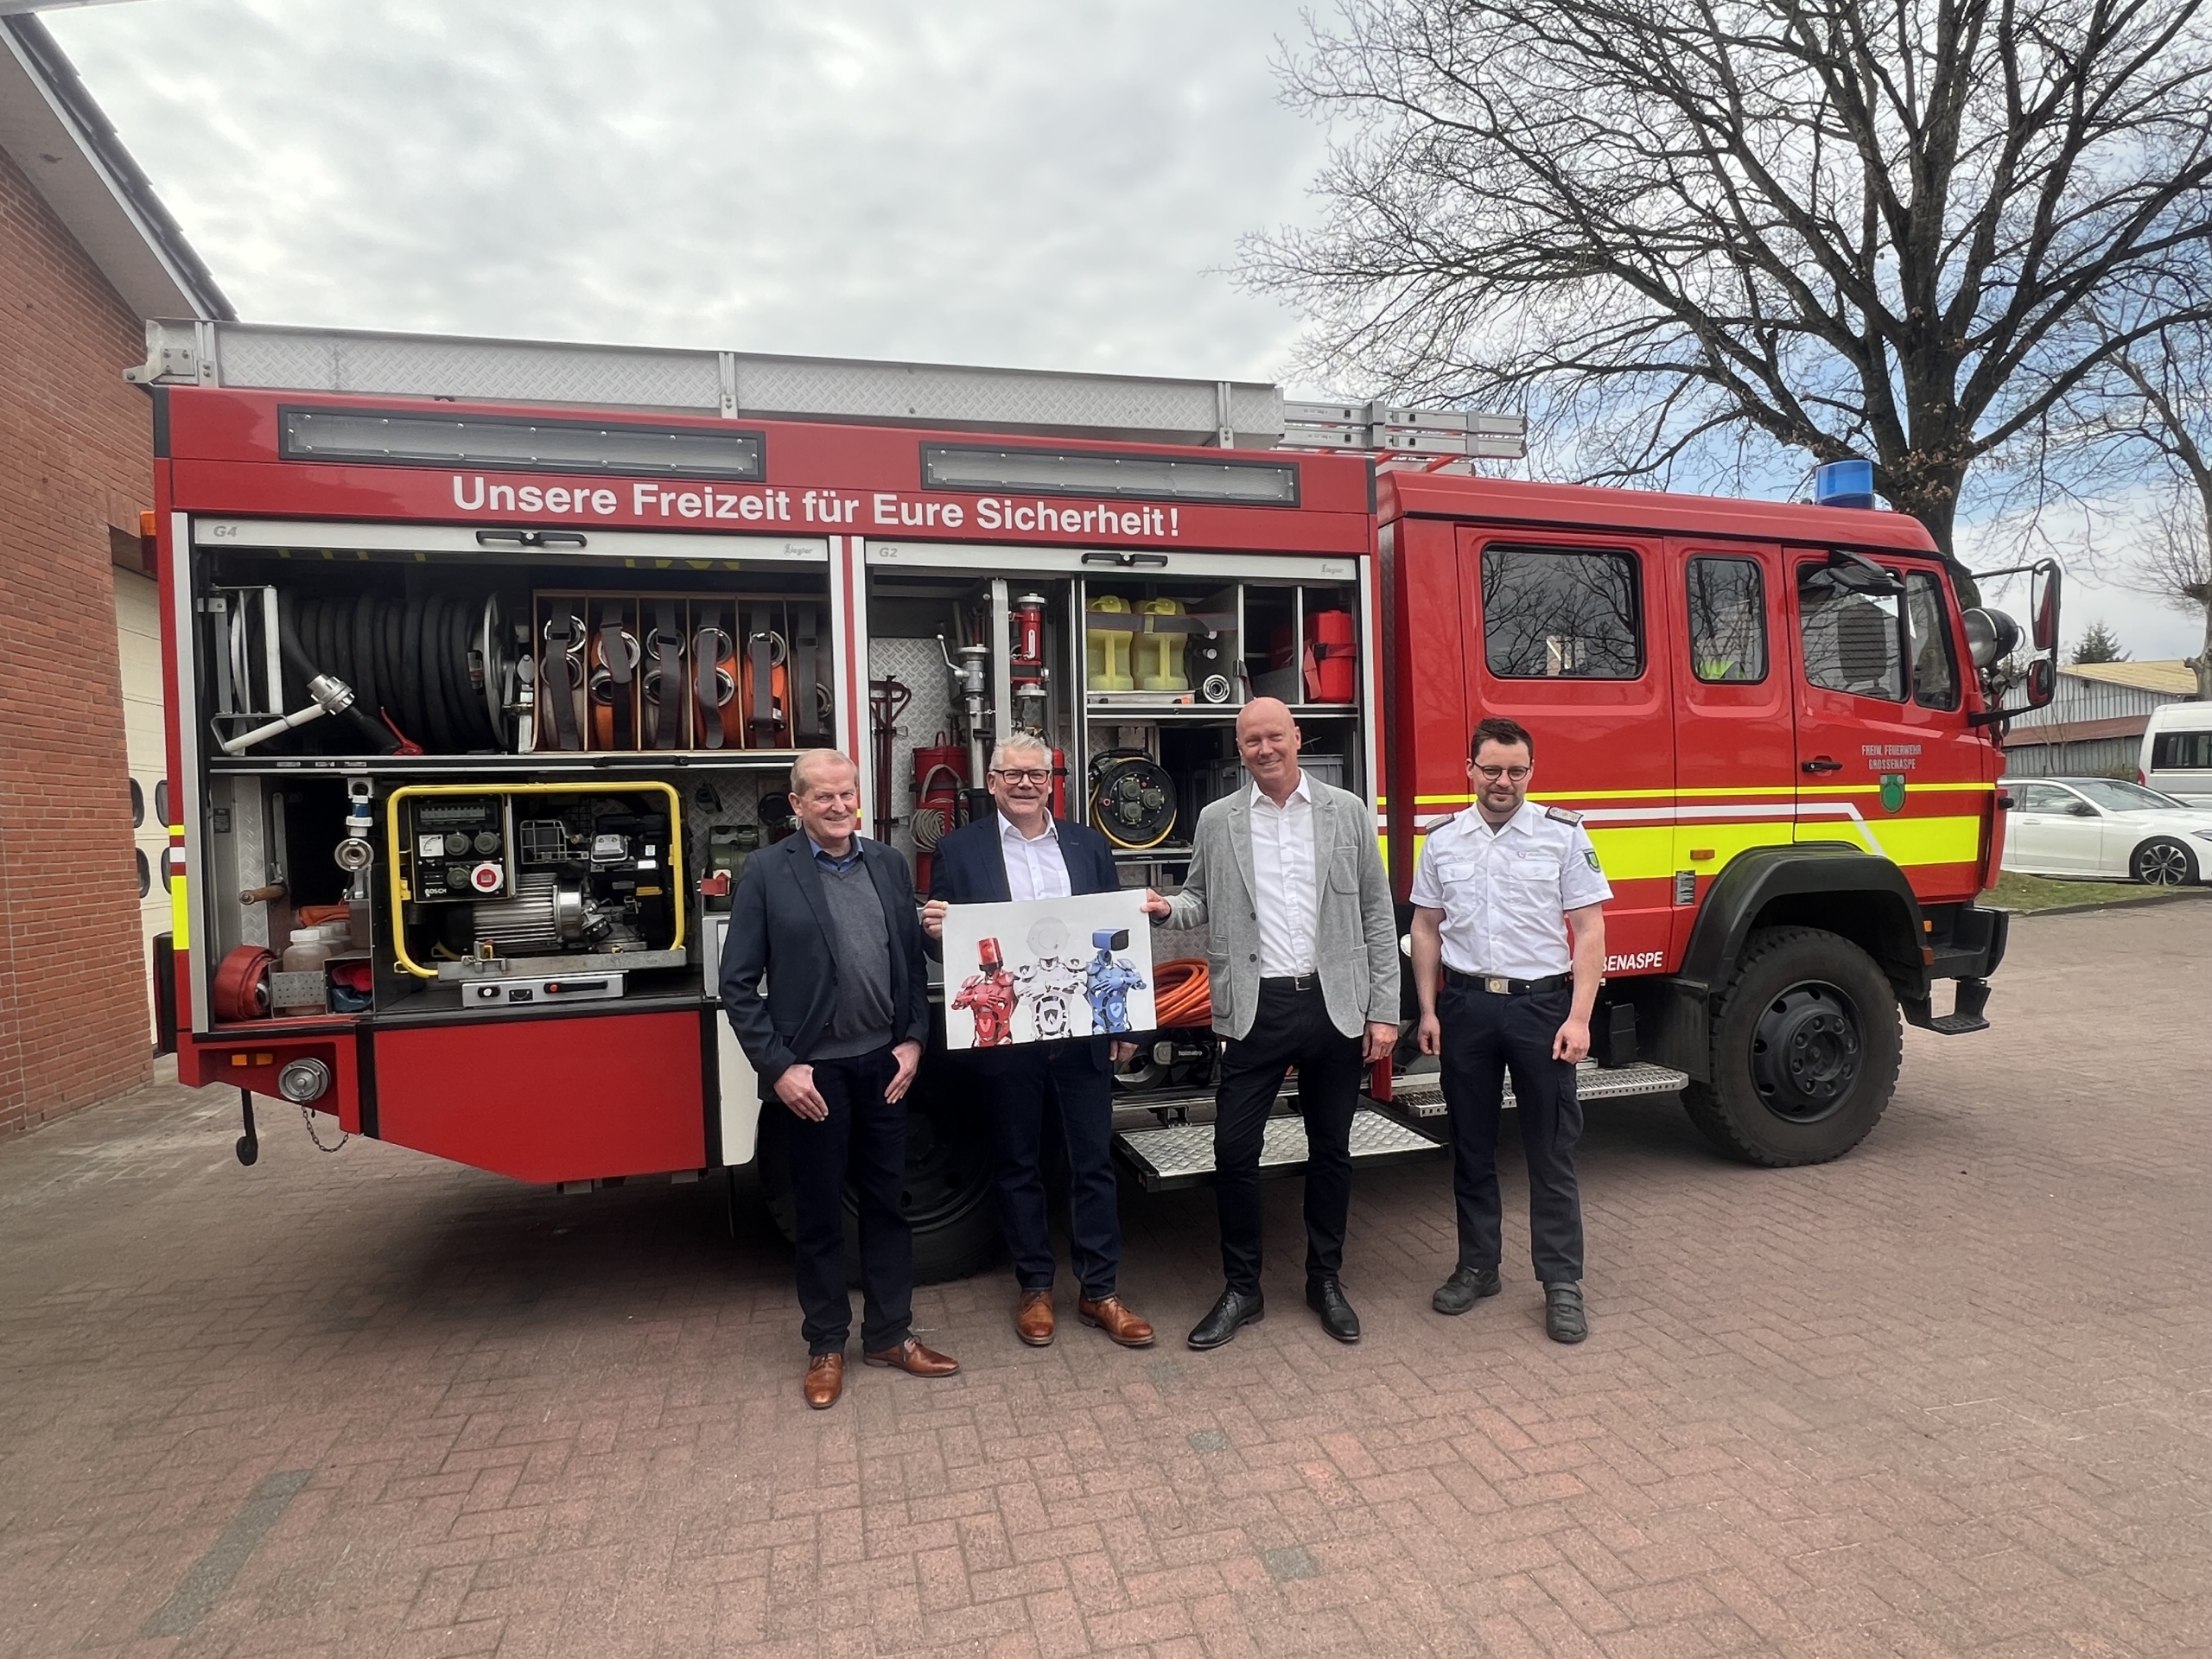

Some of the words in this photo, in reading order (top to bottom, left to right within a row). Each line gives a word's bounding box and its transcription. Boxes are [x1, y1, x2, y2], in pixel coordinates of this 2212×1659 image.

[453, 476, 617, 515] Unsere
[632, 483, 790, 521] Freizeit
[802, 490, 859, 524] für
[873, 493, 963, 528] Eure
[976, 498, 1179, 537] Sicherheit!
[213, 525, 238, 537] G4
[879, 547, 899, 558] G2
[1884, 744, 1923, 755] FEUERWEHR
[1868, 758, 1916, 770] GROSSENASPE
